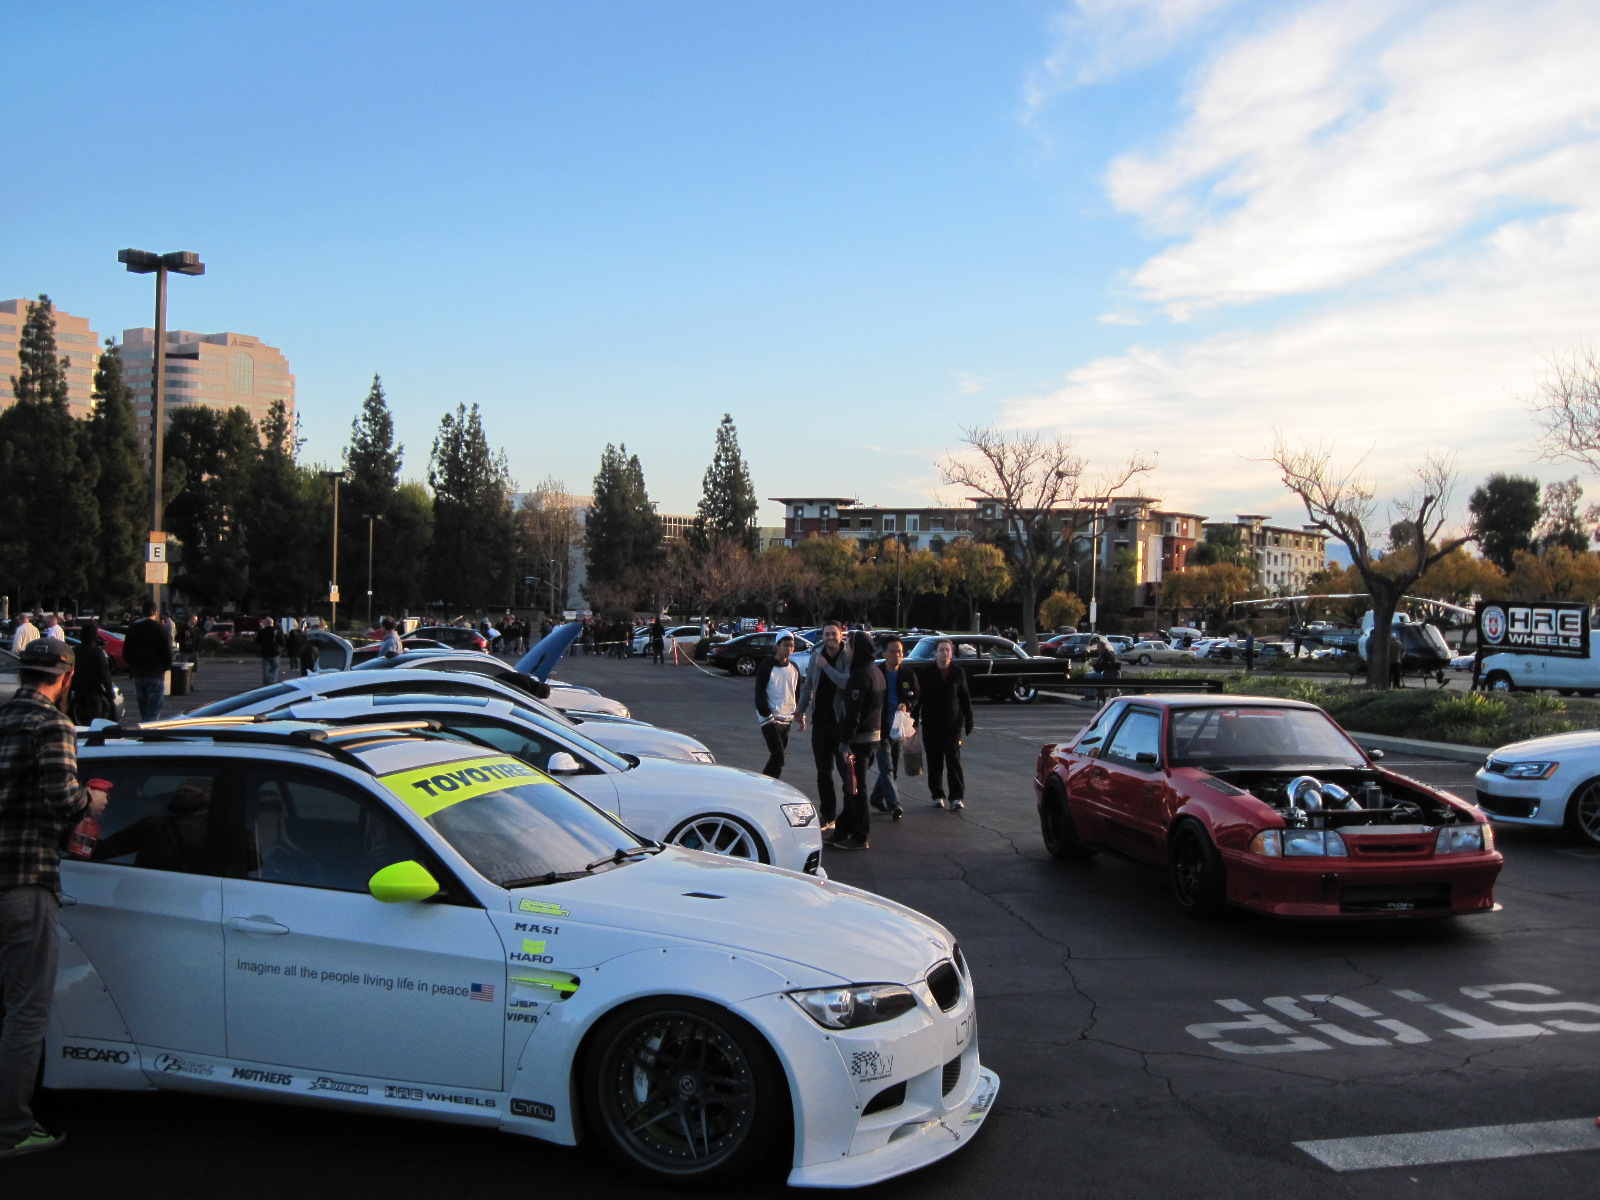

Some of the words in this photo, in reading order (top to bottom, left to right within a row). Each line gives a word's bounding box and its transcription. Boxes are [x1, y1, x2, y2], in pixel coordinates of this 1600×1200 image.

[154, 547, 160, 557] E
[1508, 607, 1581, 636] HRE
[1508, 633, 1581, 647] WHEELS
[514, 922, 560, 935] MASI
[510, 952, 554, 964] HARO
[237, 958, 281, 975] Imagine
[284, 965, 297, 976] all
[300, 966, 318, 979] the
[321, 971, 360, 984] people
[363, 973, 394, 990] living
[397, 977, 414, 990] life
[418, 980, 428, 992] in
[431, 983, 469, 997] peace
[507, 1012, 538, 1024] VIPER
[1185, 983, 1600, 1055] STOP
[62, 1046, 130, 1064] RECARO
[860, 1054, 894, 1078] KW
[231, 1067, 293, 1086] MOTHERS
[384, 1085, 424, 1100] HRE
[426, 1092, 497, 1108] WHEELS
